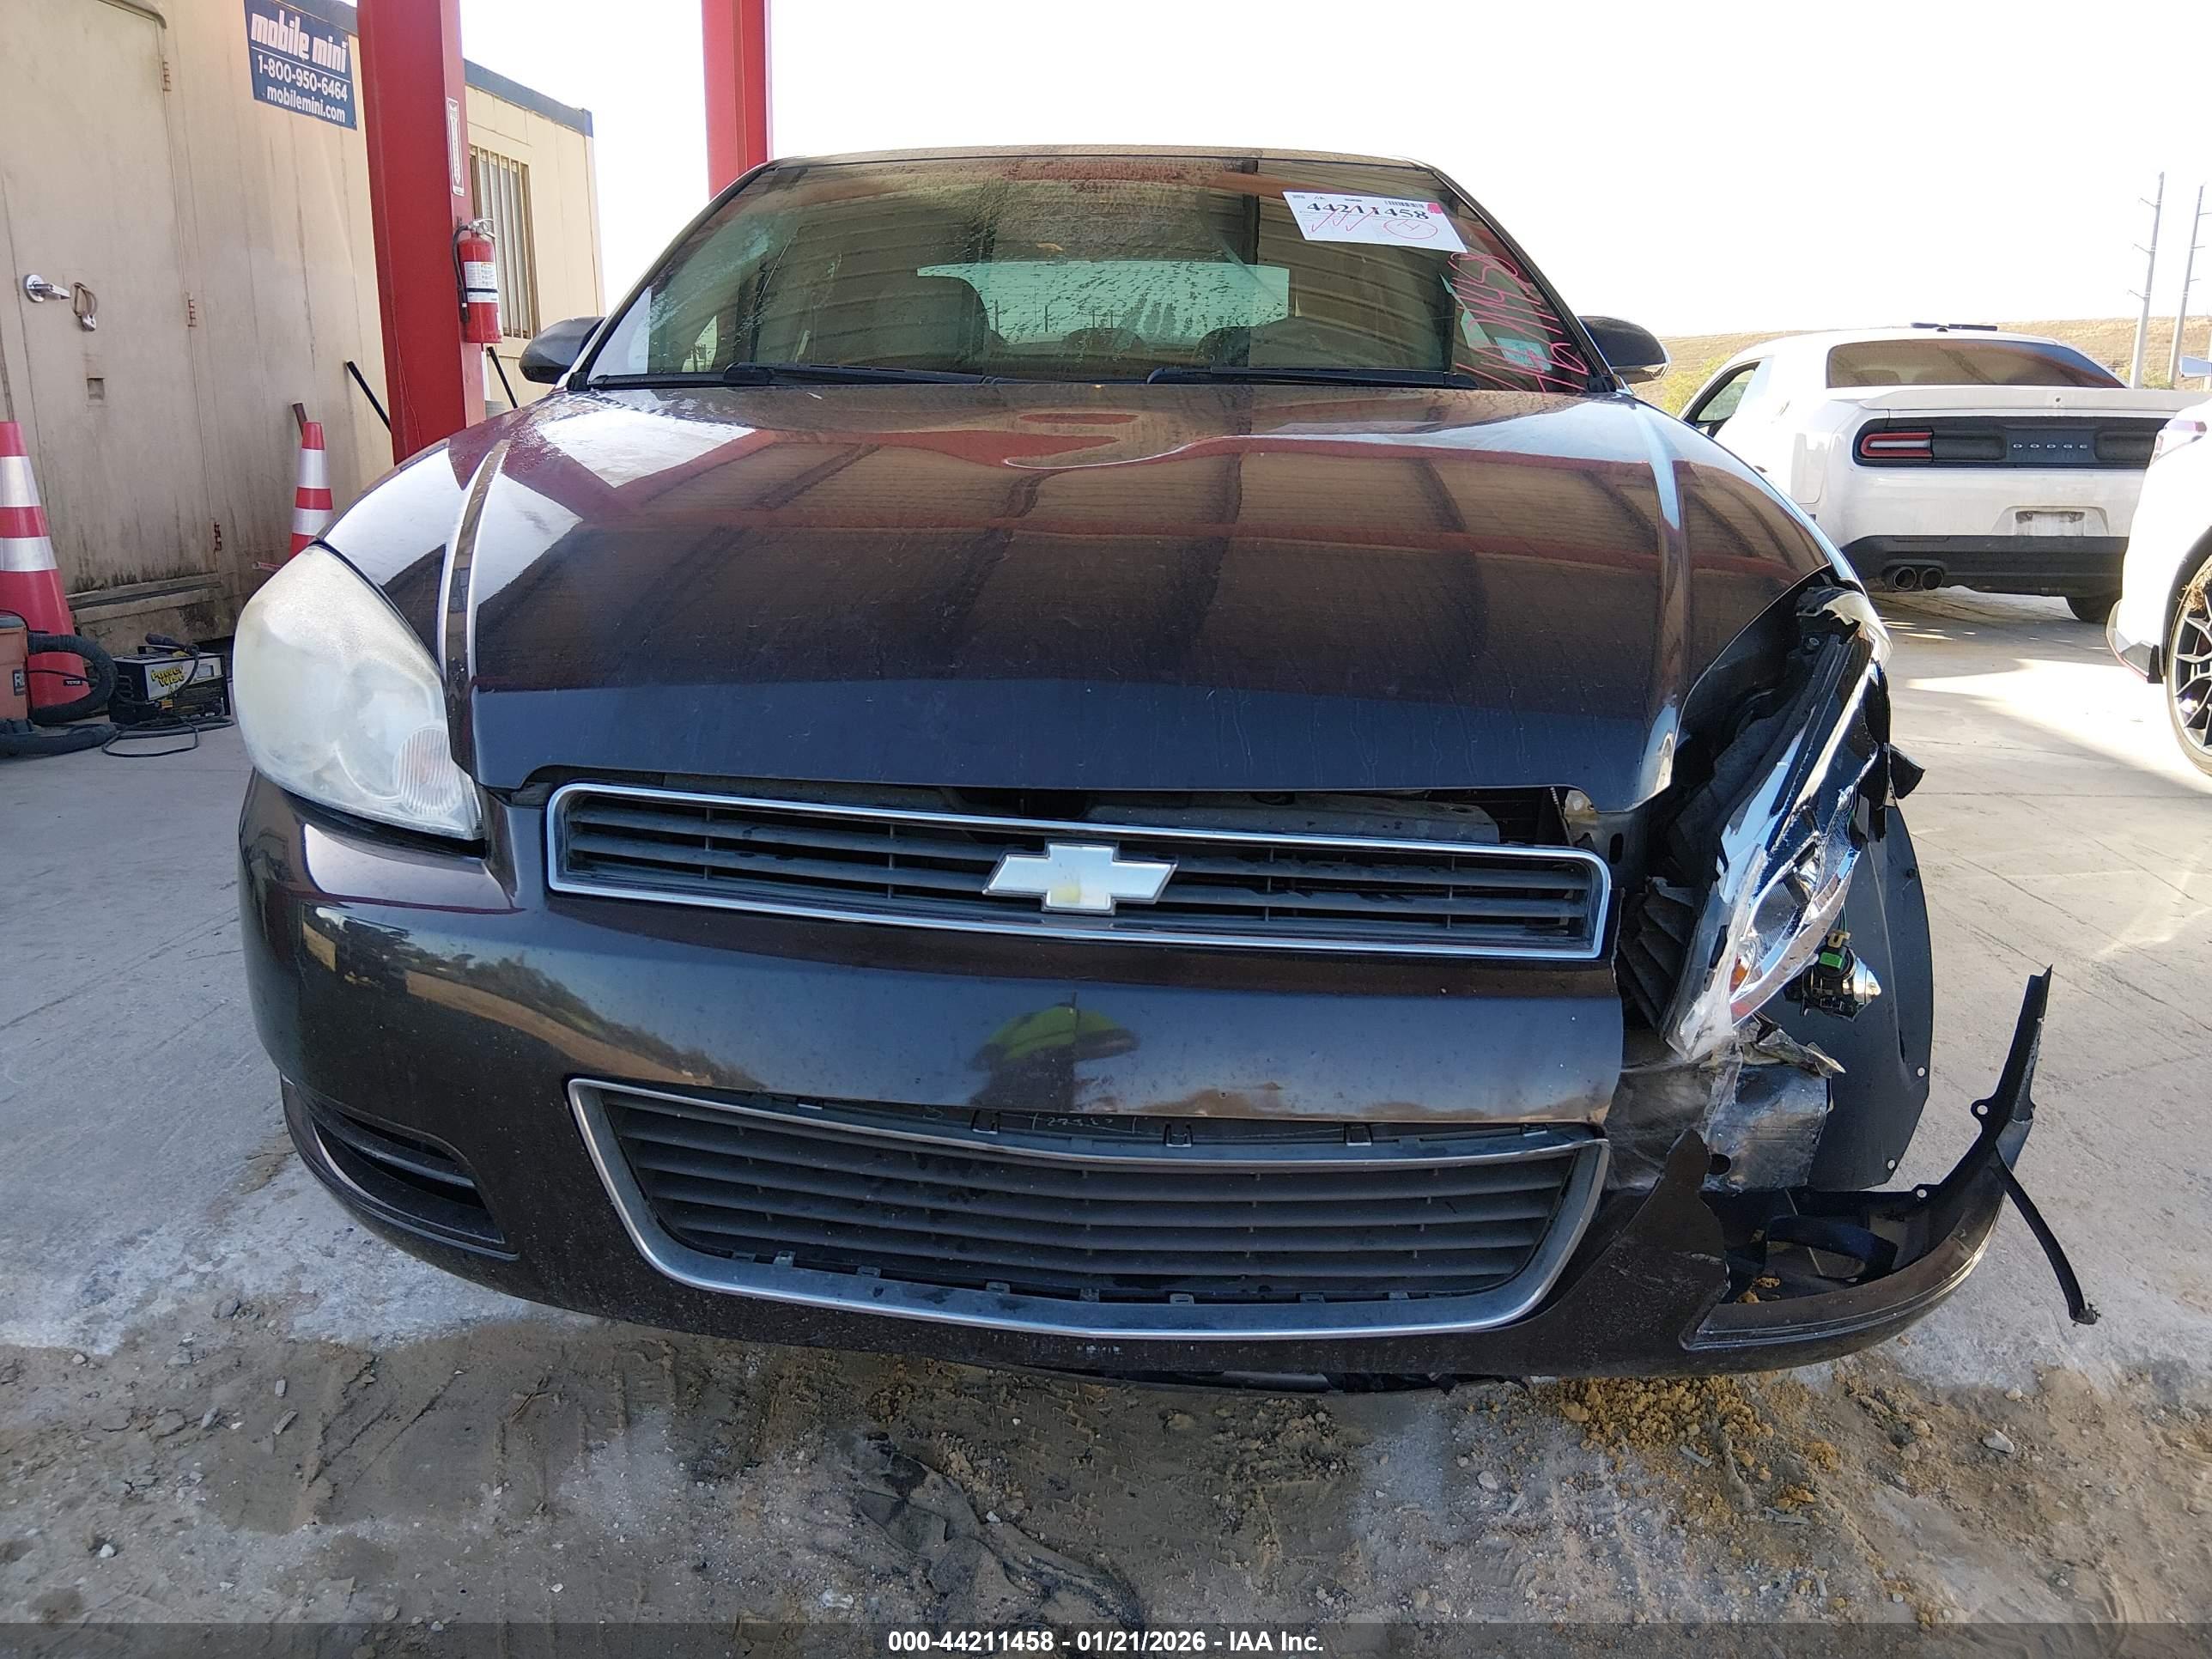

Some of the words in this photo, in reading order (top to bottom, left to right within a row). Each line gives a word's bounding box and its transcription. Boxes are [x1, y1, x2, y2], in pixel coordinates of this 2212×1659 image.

[251, 9, 309, 60] mobile
[312, 35, 347, 73] mini
[258, 54, 348, 101] 1-800-950-6464
[266, 85, 345, 123] mobilemini.com
[1306, 203, 1430, 220] 44211458
